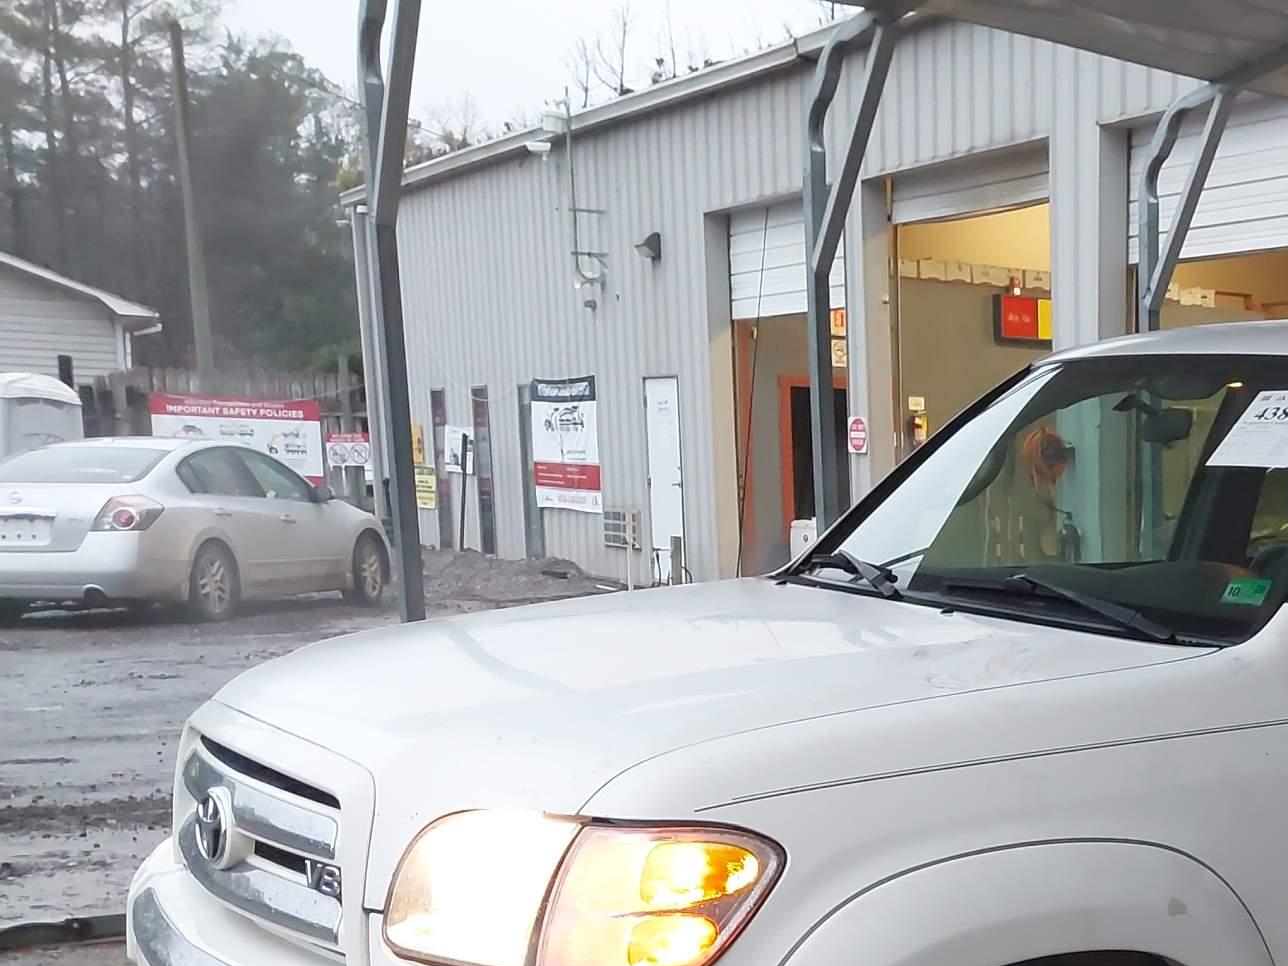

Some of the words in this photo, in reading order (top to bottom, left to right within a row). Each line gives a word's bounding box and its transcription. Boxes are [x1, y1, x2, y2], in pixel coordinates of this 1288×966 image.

[166, 404, 220, 415] IMPORTANT
[222, 406, 257, 416] SAFETY
[260, 408, 304, 419] POLICIES
[1227, 586, 1241, 597] 10
[305, 859, 341, 895] V8
